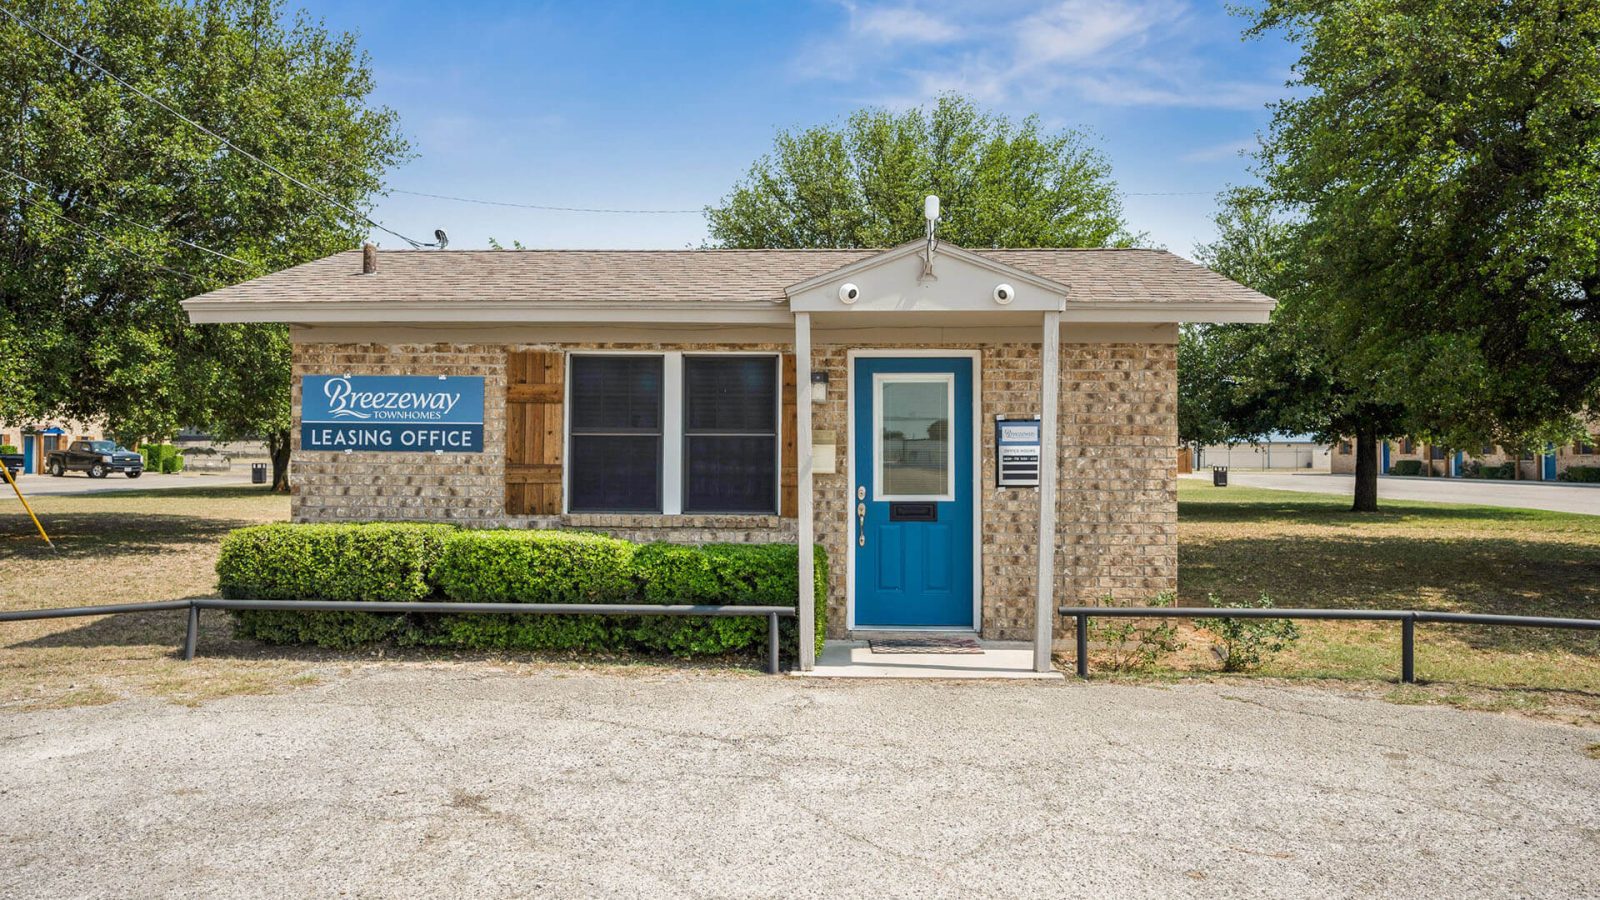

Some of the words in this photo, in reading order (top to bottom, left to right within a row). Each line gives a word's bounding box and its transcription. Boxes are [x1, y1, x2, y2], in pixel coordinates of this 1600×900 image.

[323, 377, 461, 415] Breezeway
[372, 410, 441, 420] TOWNHOMES
[311, 429, 393, 446] LEASING
[400, 430, 473, 447] OFFICE
